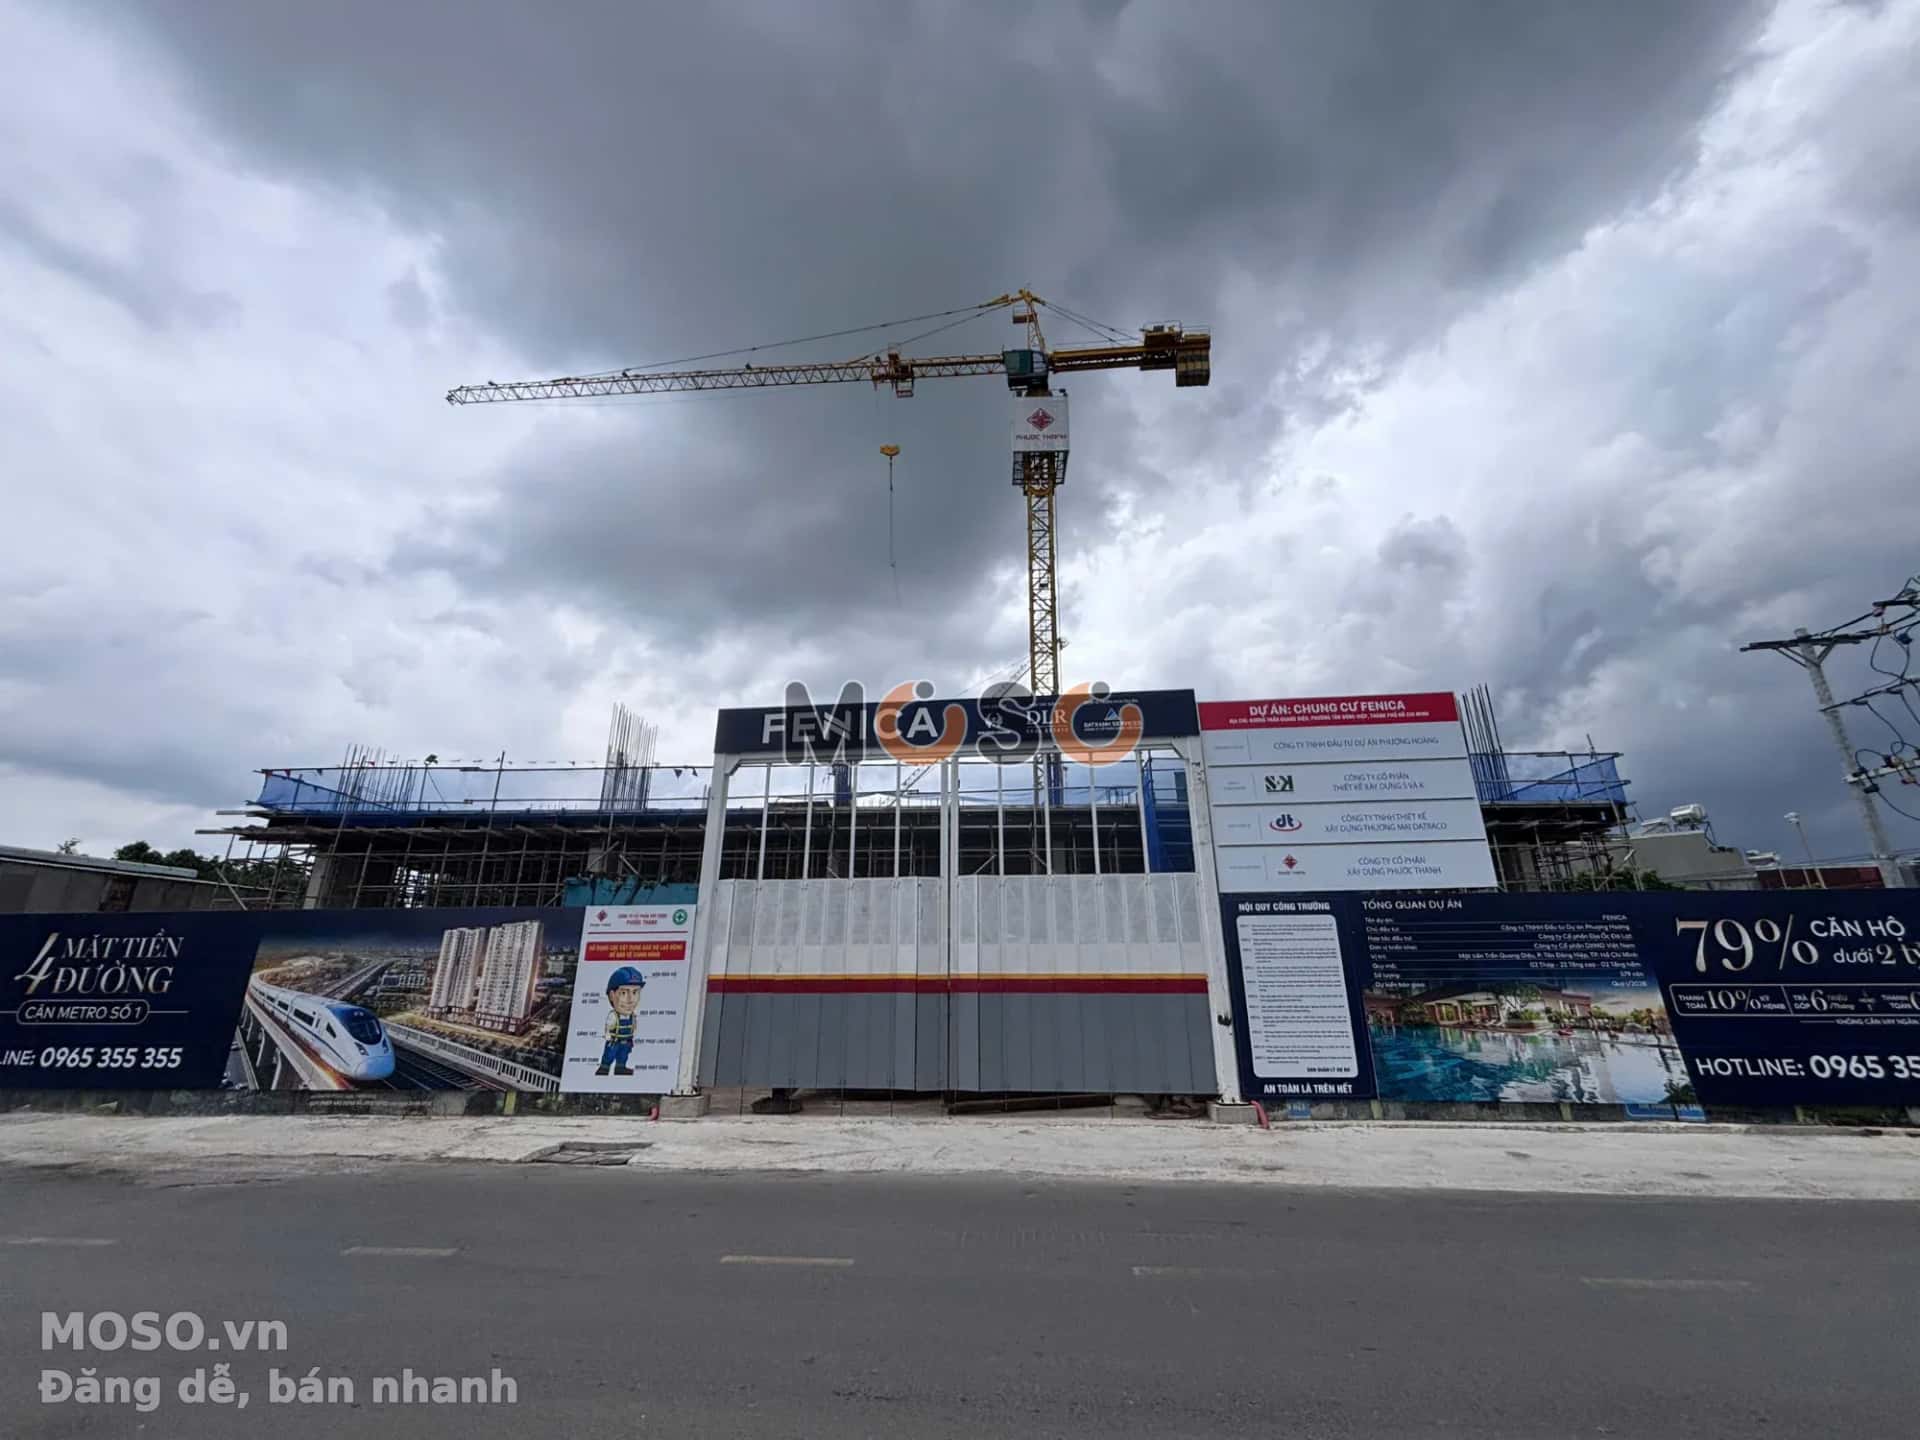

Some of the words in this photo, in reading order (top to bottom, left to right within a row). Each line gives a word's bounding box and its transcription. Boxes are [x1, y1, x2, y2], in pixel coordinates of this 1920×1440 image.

[1026, 709, 1068, 725] DLR
[1249, 704, 1268, 718] DỰ
[1270, 702, 1292, 715] ÁN:
[1294, 703, 1337, 714] CHUNG
[1340, 700, 1359, 712] CƯ
[1360, 700, 1406, 711] FENICA
[762, 706, 938, 744] FENICA
[1238, 902, 1253, 912] NỘI
[1255, 902, 1271, 912] QUY
[1273, 901, 1296, 911] CÔNG
[1298, 900, 1330, 911] TRƯỜNG
[1362, 898, 1393, 910] TỔNG
[1395, 900, 1426, 910] QUAN
[1428, 900, 1444, 912] DỰ
[1447, 898, 1462, 909] ÁN
[1810, 916, 1864, 937] CĂN
[1866, 916, 1906, 942] HỘ
[61, 934, 119, 963] MẶT
[122, 928, 185, 959] TIỀN
[1675, 914, 1819, 973] 79%
[1833, 948, 1874, 964] dưới
[1876, 944, 1897, 965] 2
[14, 932, 60, 995] 4
[52, 960, 174, 994] ĐƯỜNG
[57, 1006, 108, 1020] METRO
[109, 1002, 132, 1020] SỐ
[134, 1006, 143, 1019] 1
[1705, 989, 1761, 1012] 10%
[1811, 989, 1828, 1011] 6
[40, 1047, 95, 1068] 0965
[96, 1047, 139, 1068] 355
[140, 1047, 184, 1068] 355
[1695, 1058, 1806, 1077] HOTLINE:
[1809, 1055, 1886, 1079] 0965
[1264, 1084, 1276, 1094] AN
[1277, 1082, 1300, 1094] TOÀN
[1301, 1082, 1312, 1094] LÀ
[1313, 1082, 1336, 1094] TRÊN
[1337, 1082, 1353, 1094] HẾT
